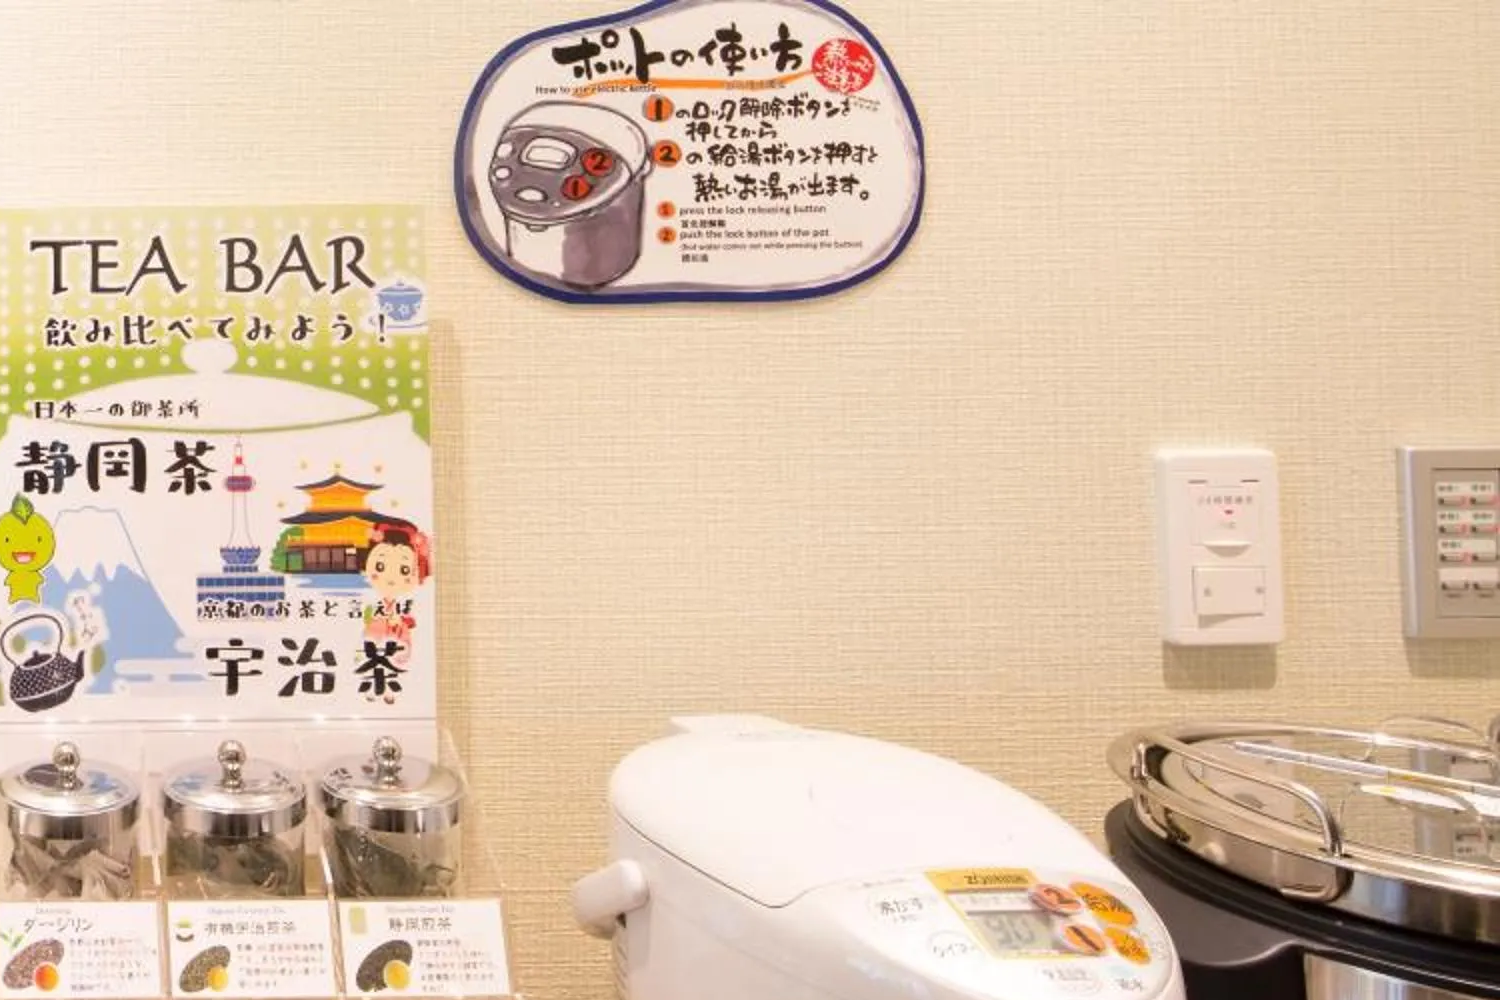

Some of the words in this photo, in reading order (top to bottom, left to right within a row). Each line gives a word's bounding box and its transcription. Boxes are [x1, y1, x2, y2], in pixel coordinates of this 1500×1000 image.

[552, 22, 803, 82] ポットの使い方
[685, 121, 778, 143] 押してから
[686, 141, 878, 168] の給湯ボタンを押すと
[707, 206, 723, 215] the
[725, 206, 744, 214] lock
[30, 234, 187, 297] TEA
[220, 234, 376, 296] BAR
[34, 399, 200, 420] 日本一の御茶所
[15, 438, 218, 495] 静岡茶
[203, 600, 413, 619] 京都のお茶と言えば
[206, 638, 407, 697] 宇治茶
[24, 918, 93, 933] ダージリン
